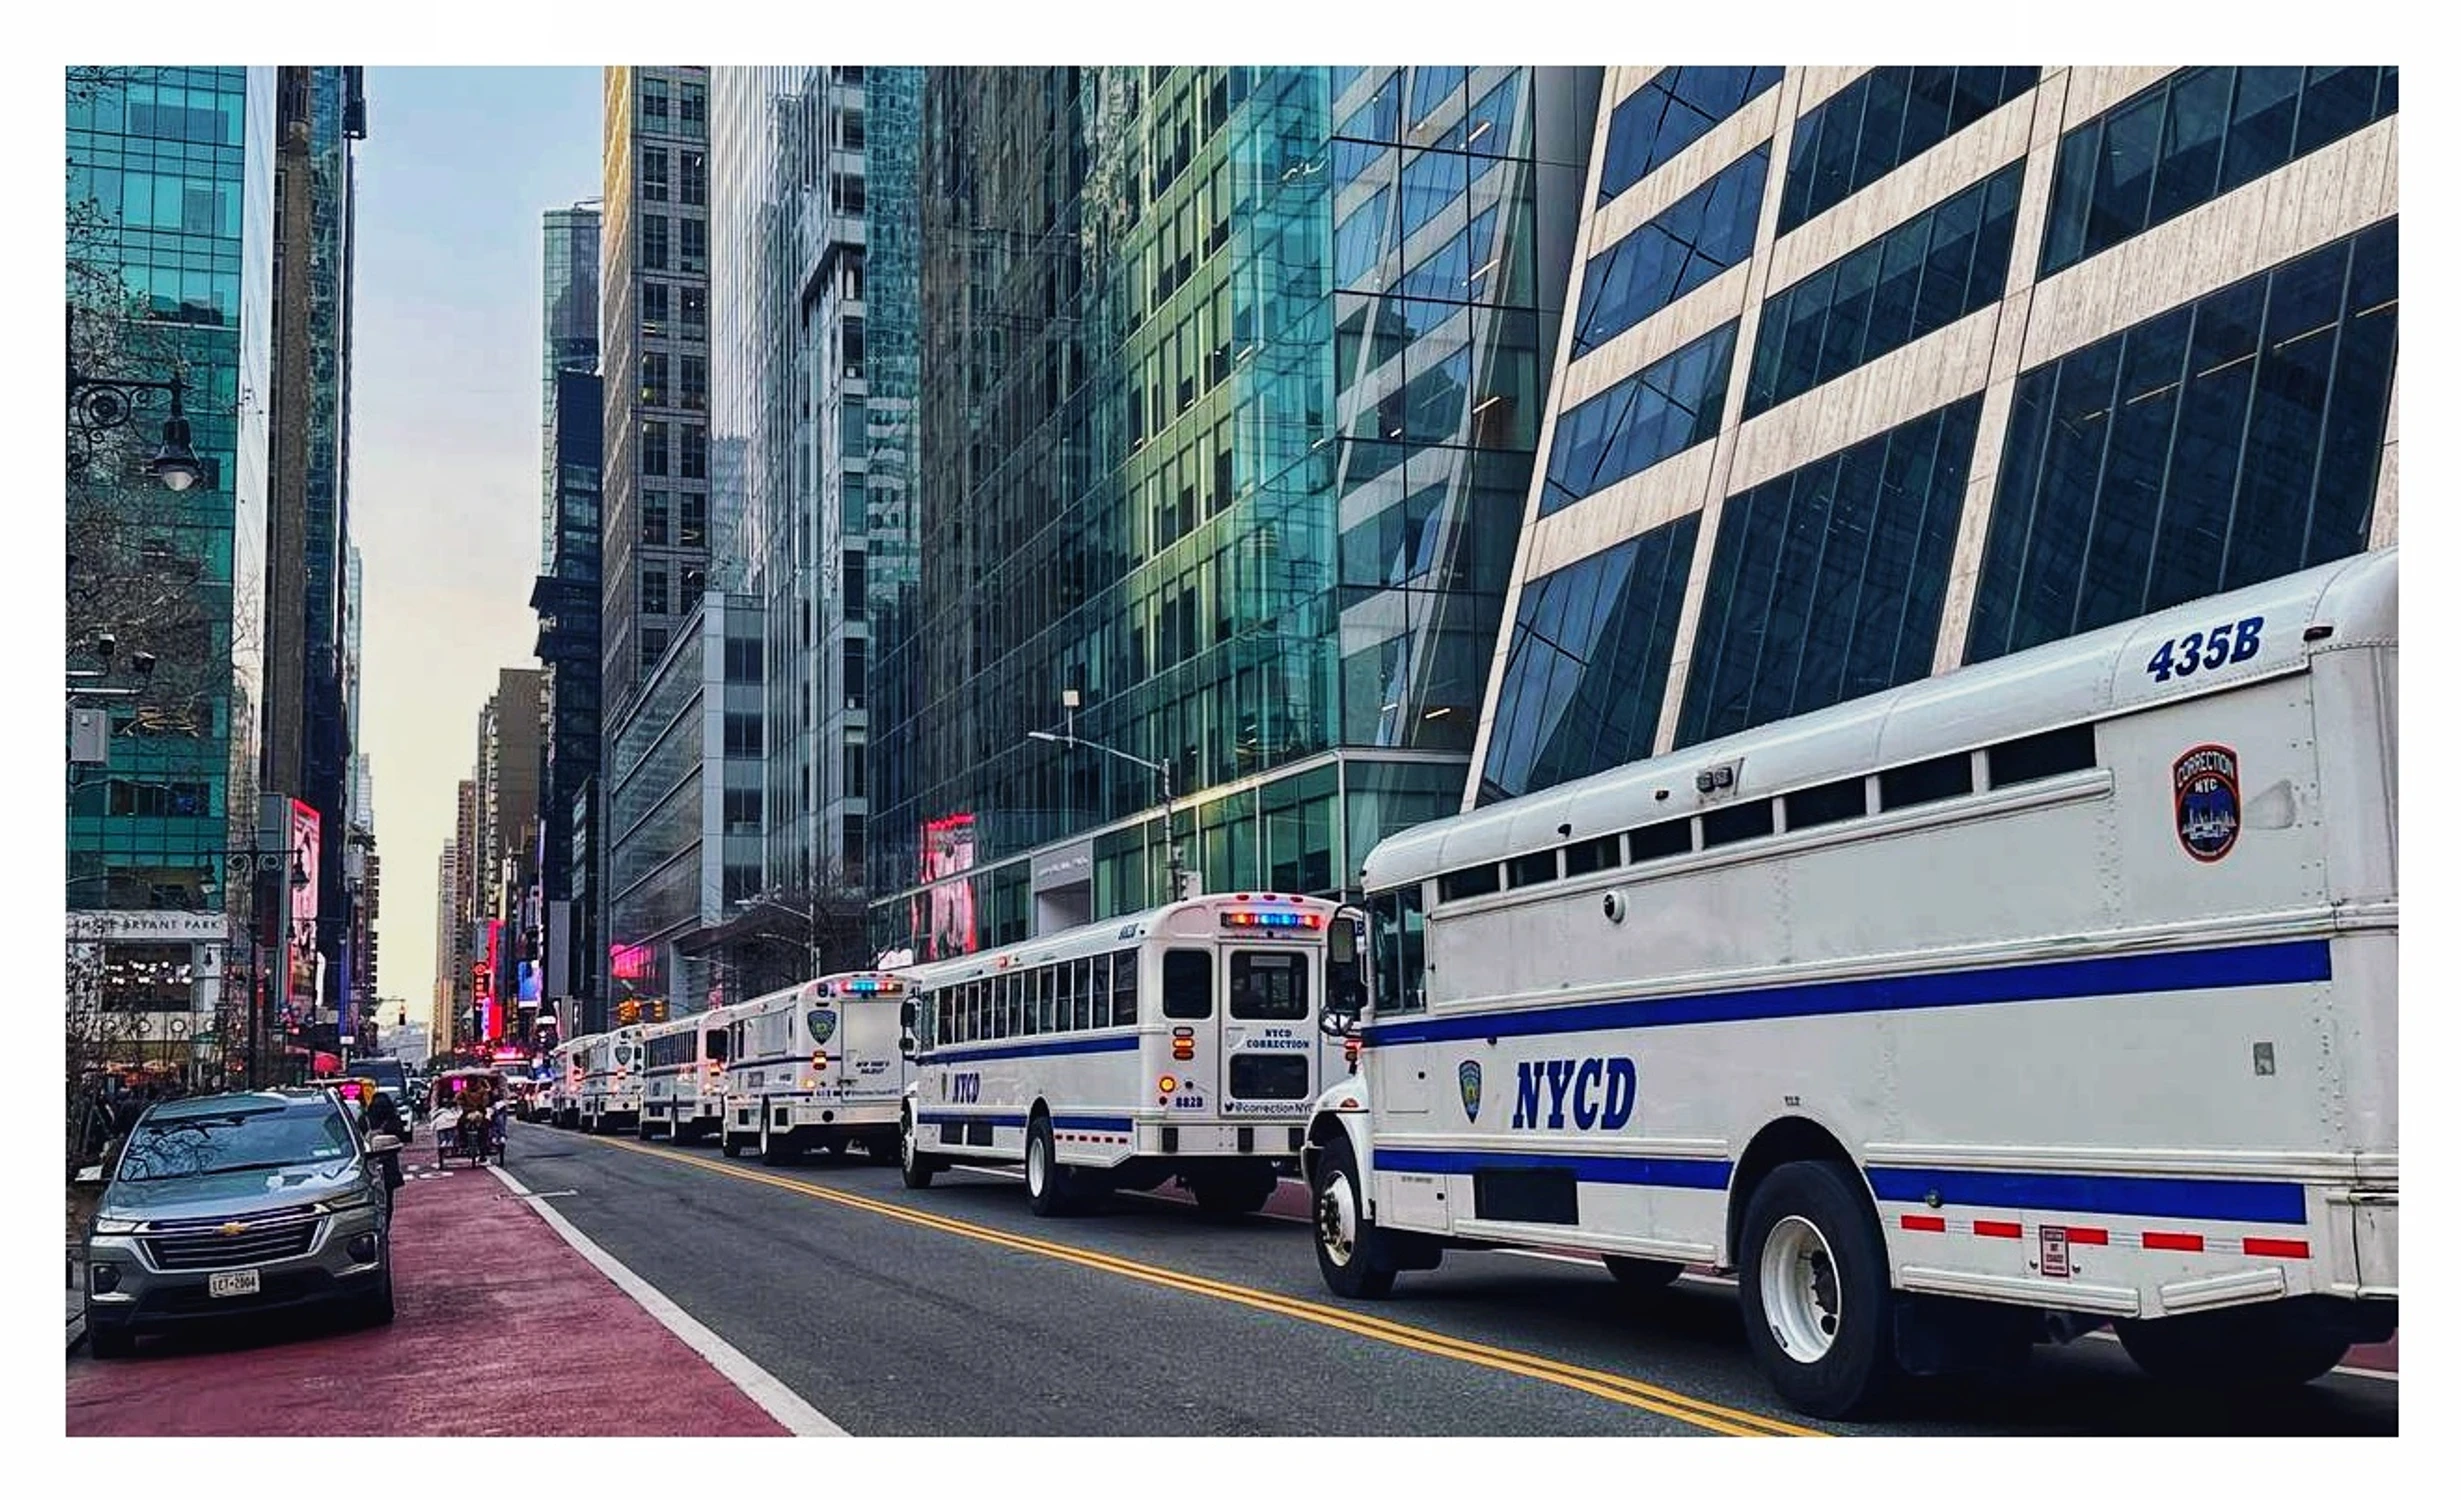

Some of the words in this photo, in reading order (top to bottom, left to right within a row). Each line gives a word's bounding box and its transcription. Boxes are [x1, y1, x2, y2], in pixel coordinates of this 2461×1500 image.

[2146, 616, 2264, 683] 435B
[2176, 750, 2235, 788] CORRECTION
[2194, 778, 2219, 793] NYC
[184, 919, 221, 931] PARK
[1246, 1039, 1310, 1049] CORRECTION
[1265, 1028, 1293, 1038] NYCD
[952, 1072, 980, 1104] NYCD
[1511, 1057, 1637, 1131] NYCD
